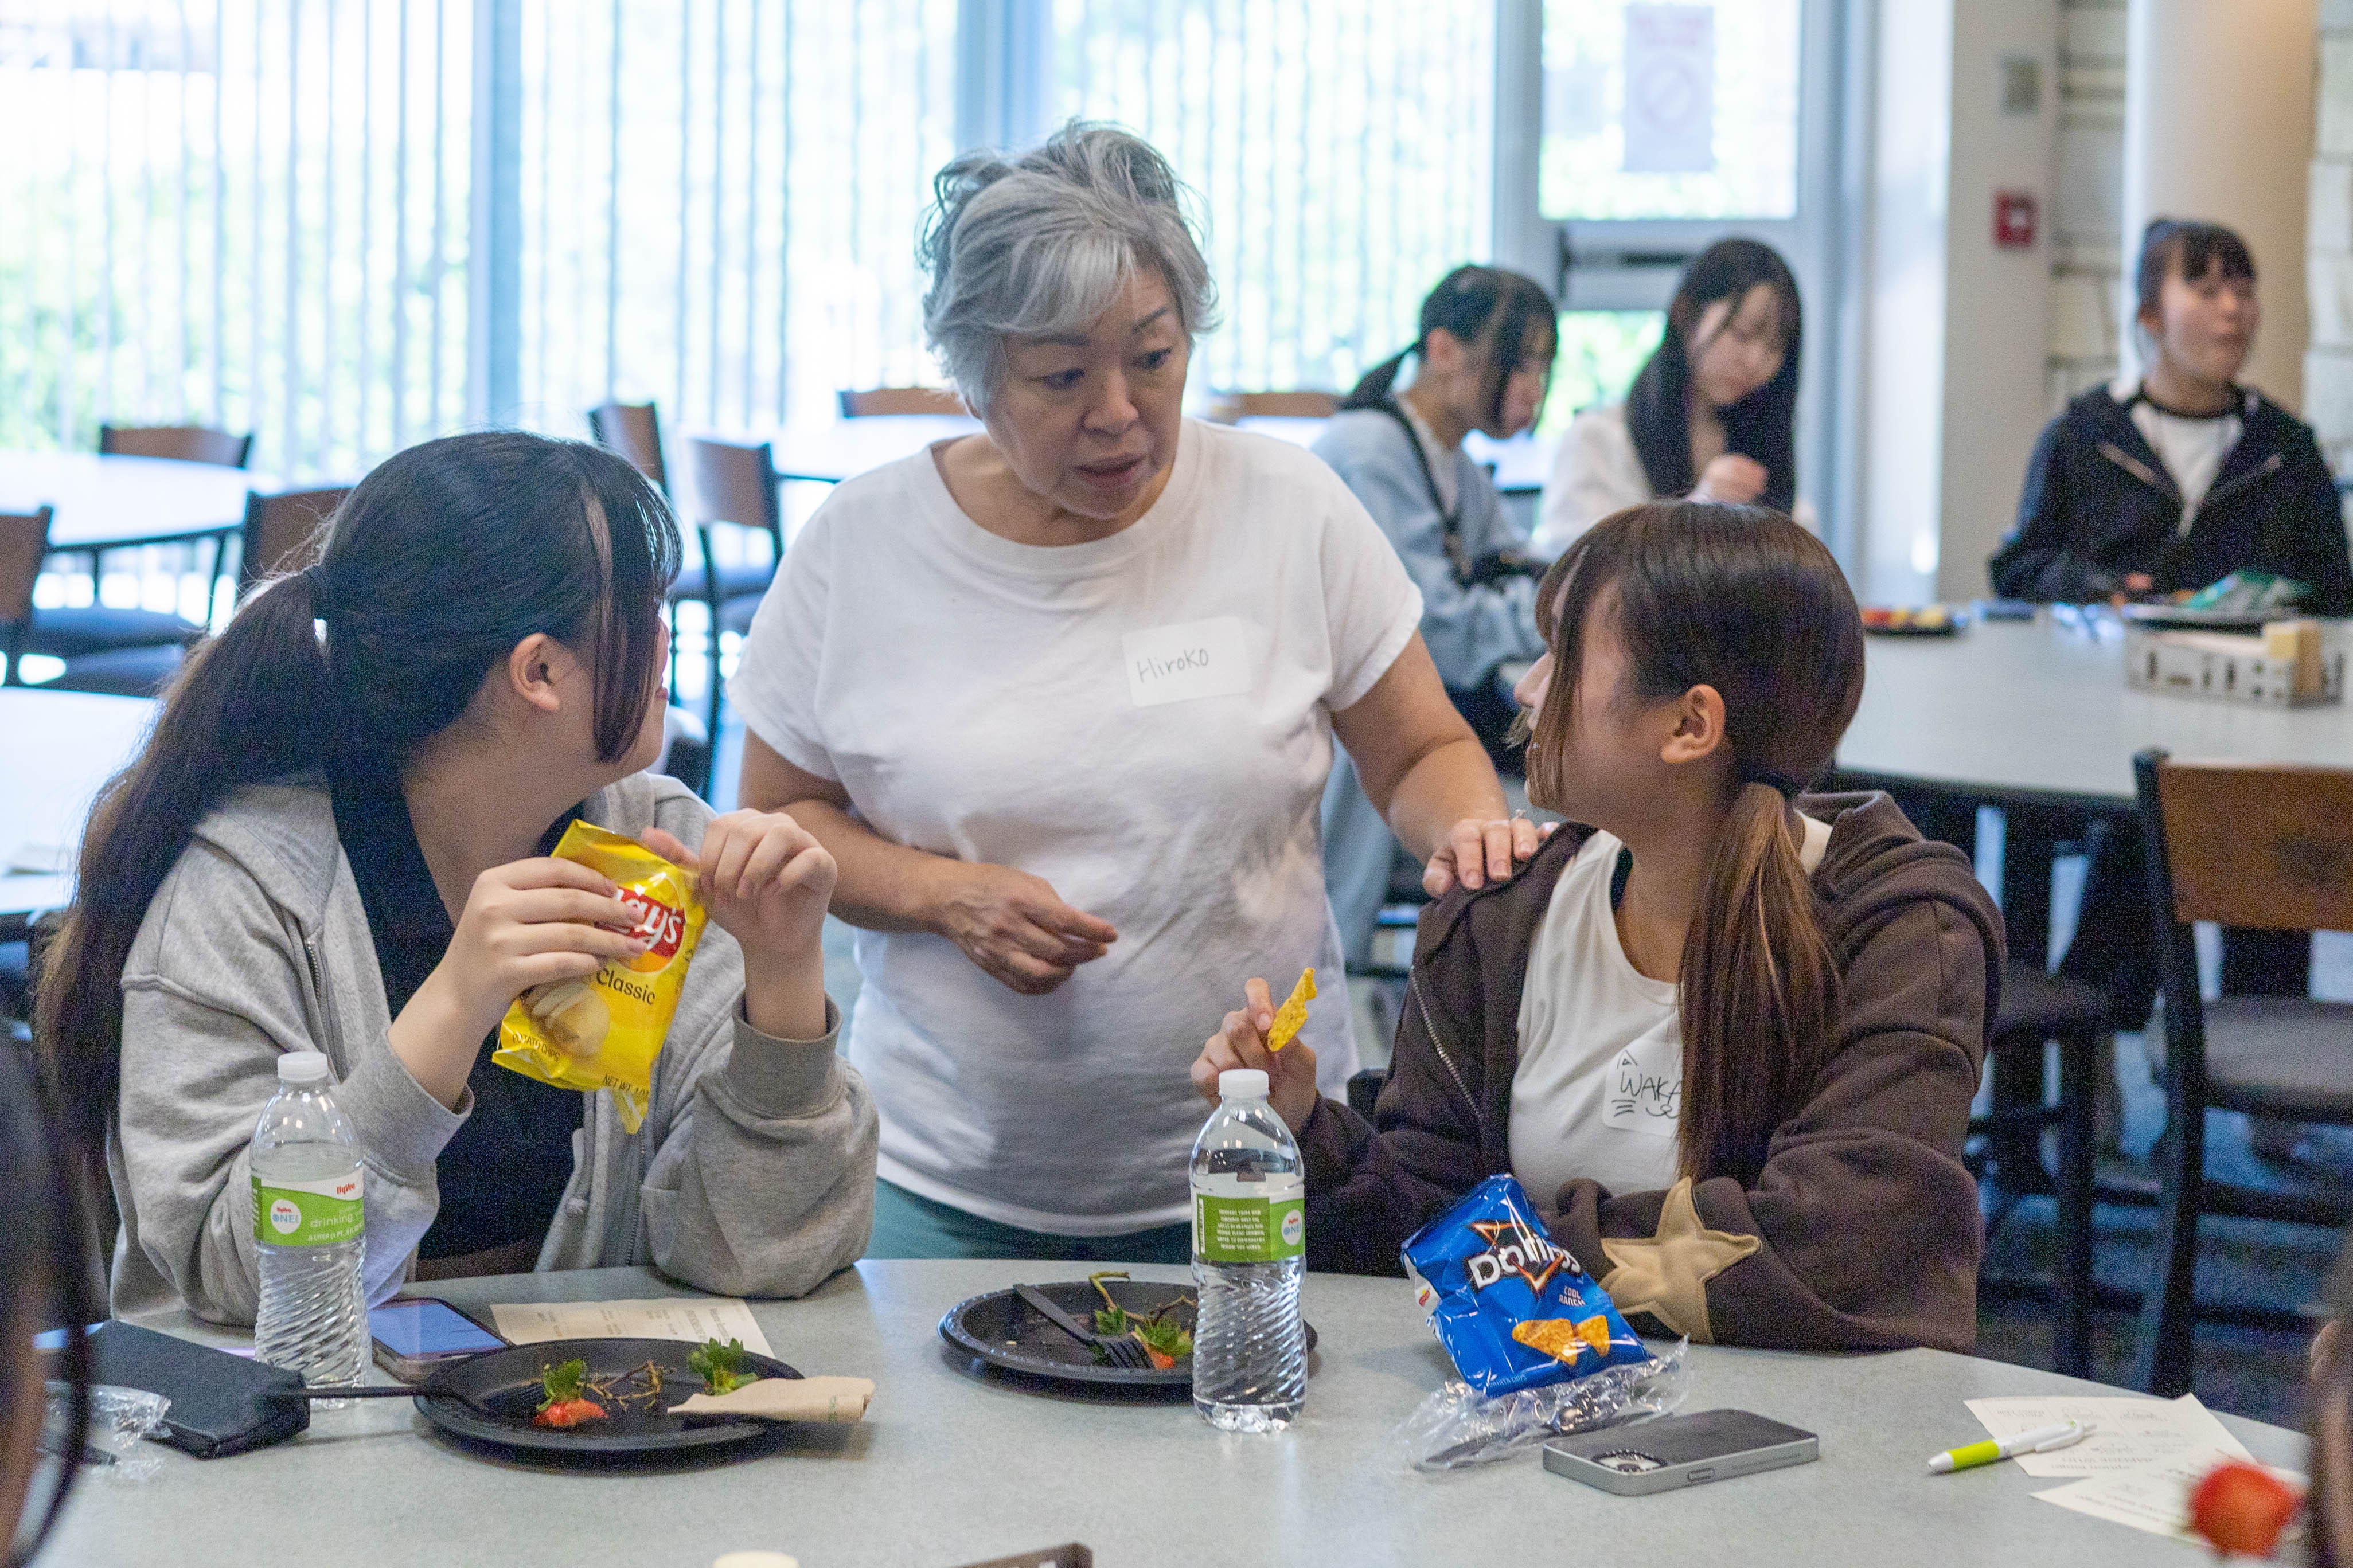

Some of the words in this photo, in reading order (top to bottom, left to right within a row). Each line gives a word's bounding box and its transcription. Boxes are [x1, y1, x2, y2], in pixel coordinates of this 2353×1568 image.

[596, 968, 655, 1006] Classic
[310, 1213, 353, 1228] drinking
[1564, 1285, 1581, 1299] COOL
[1558, 1293, 1586, 1307] RANCH
